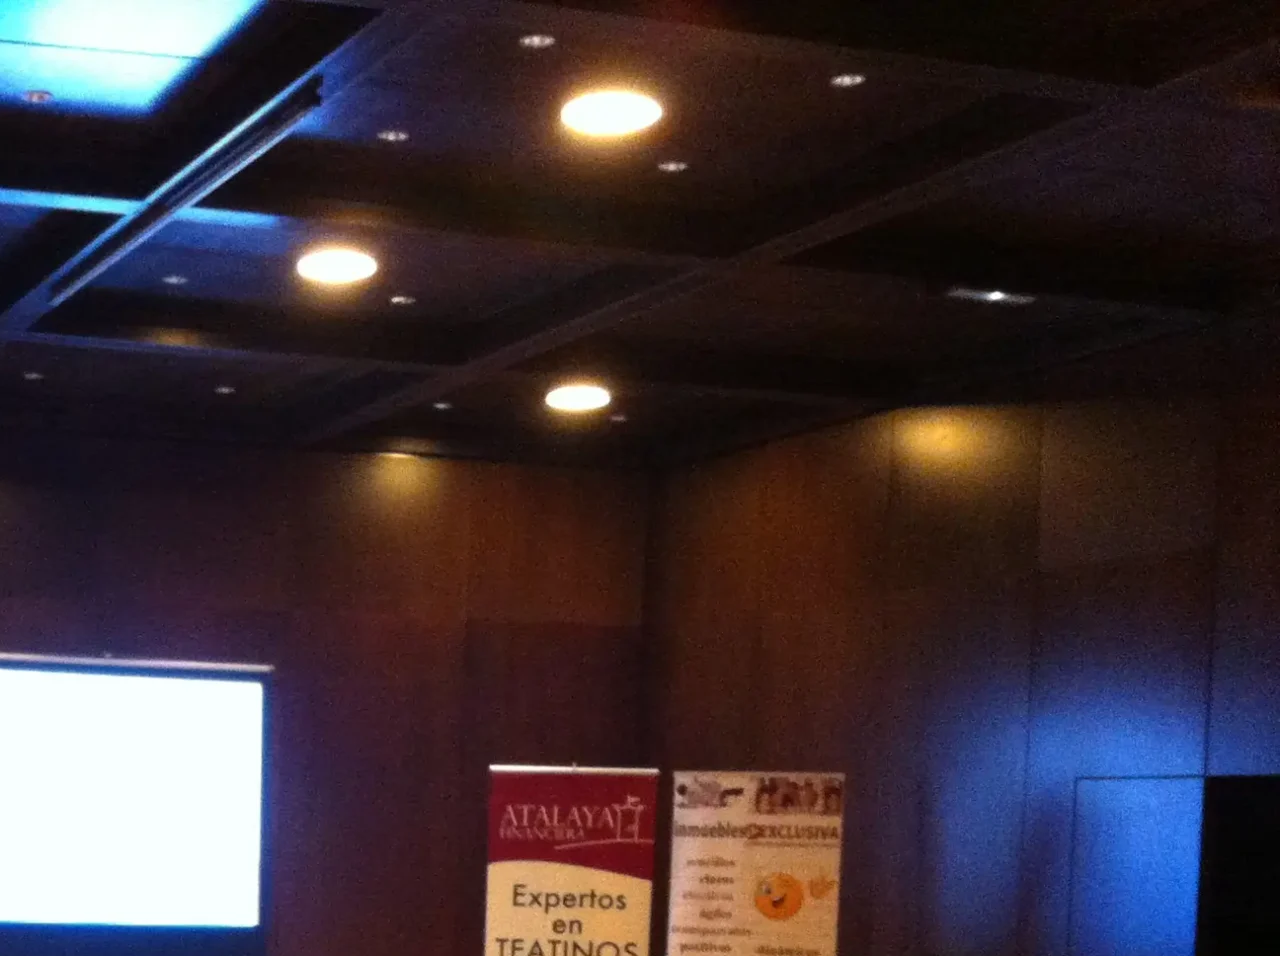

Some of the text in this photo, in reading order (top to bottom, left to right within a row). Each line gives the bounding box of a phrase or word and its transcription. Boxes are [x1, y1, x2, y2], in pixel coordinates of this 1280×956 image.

[500, 804, 615, 829] ATALAYA
[512, 884, 628, 914] Expertos
[552, 919, 582, 934] en
